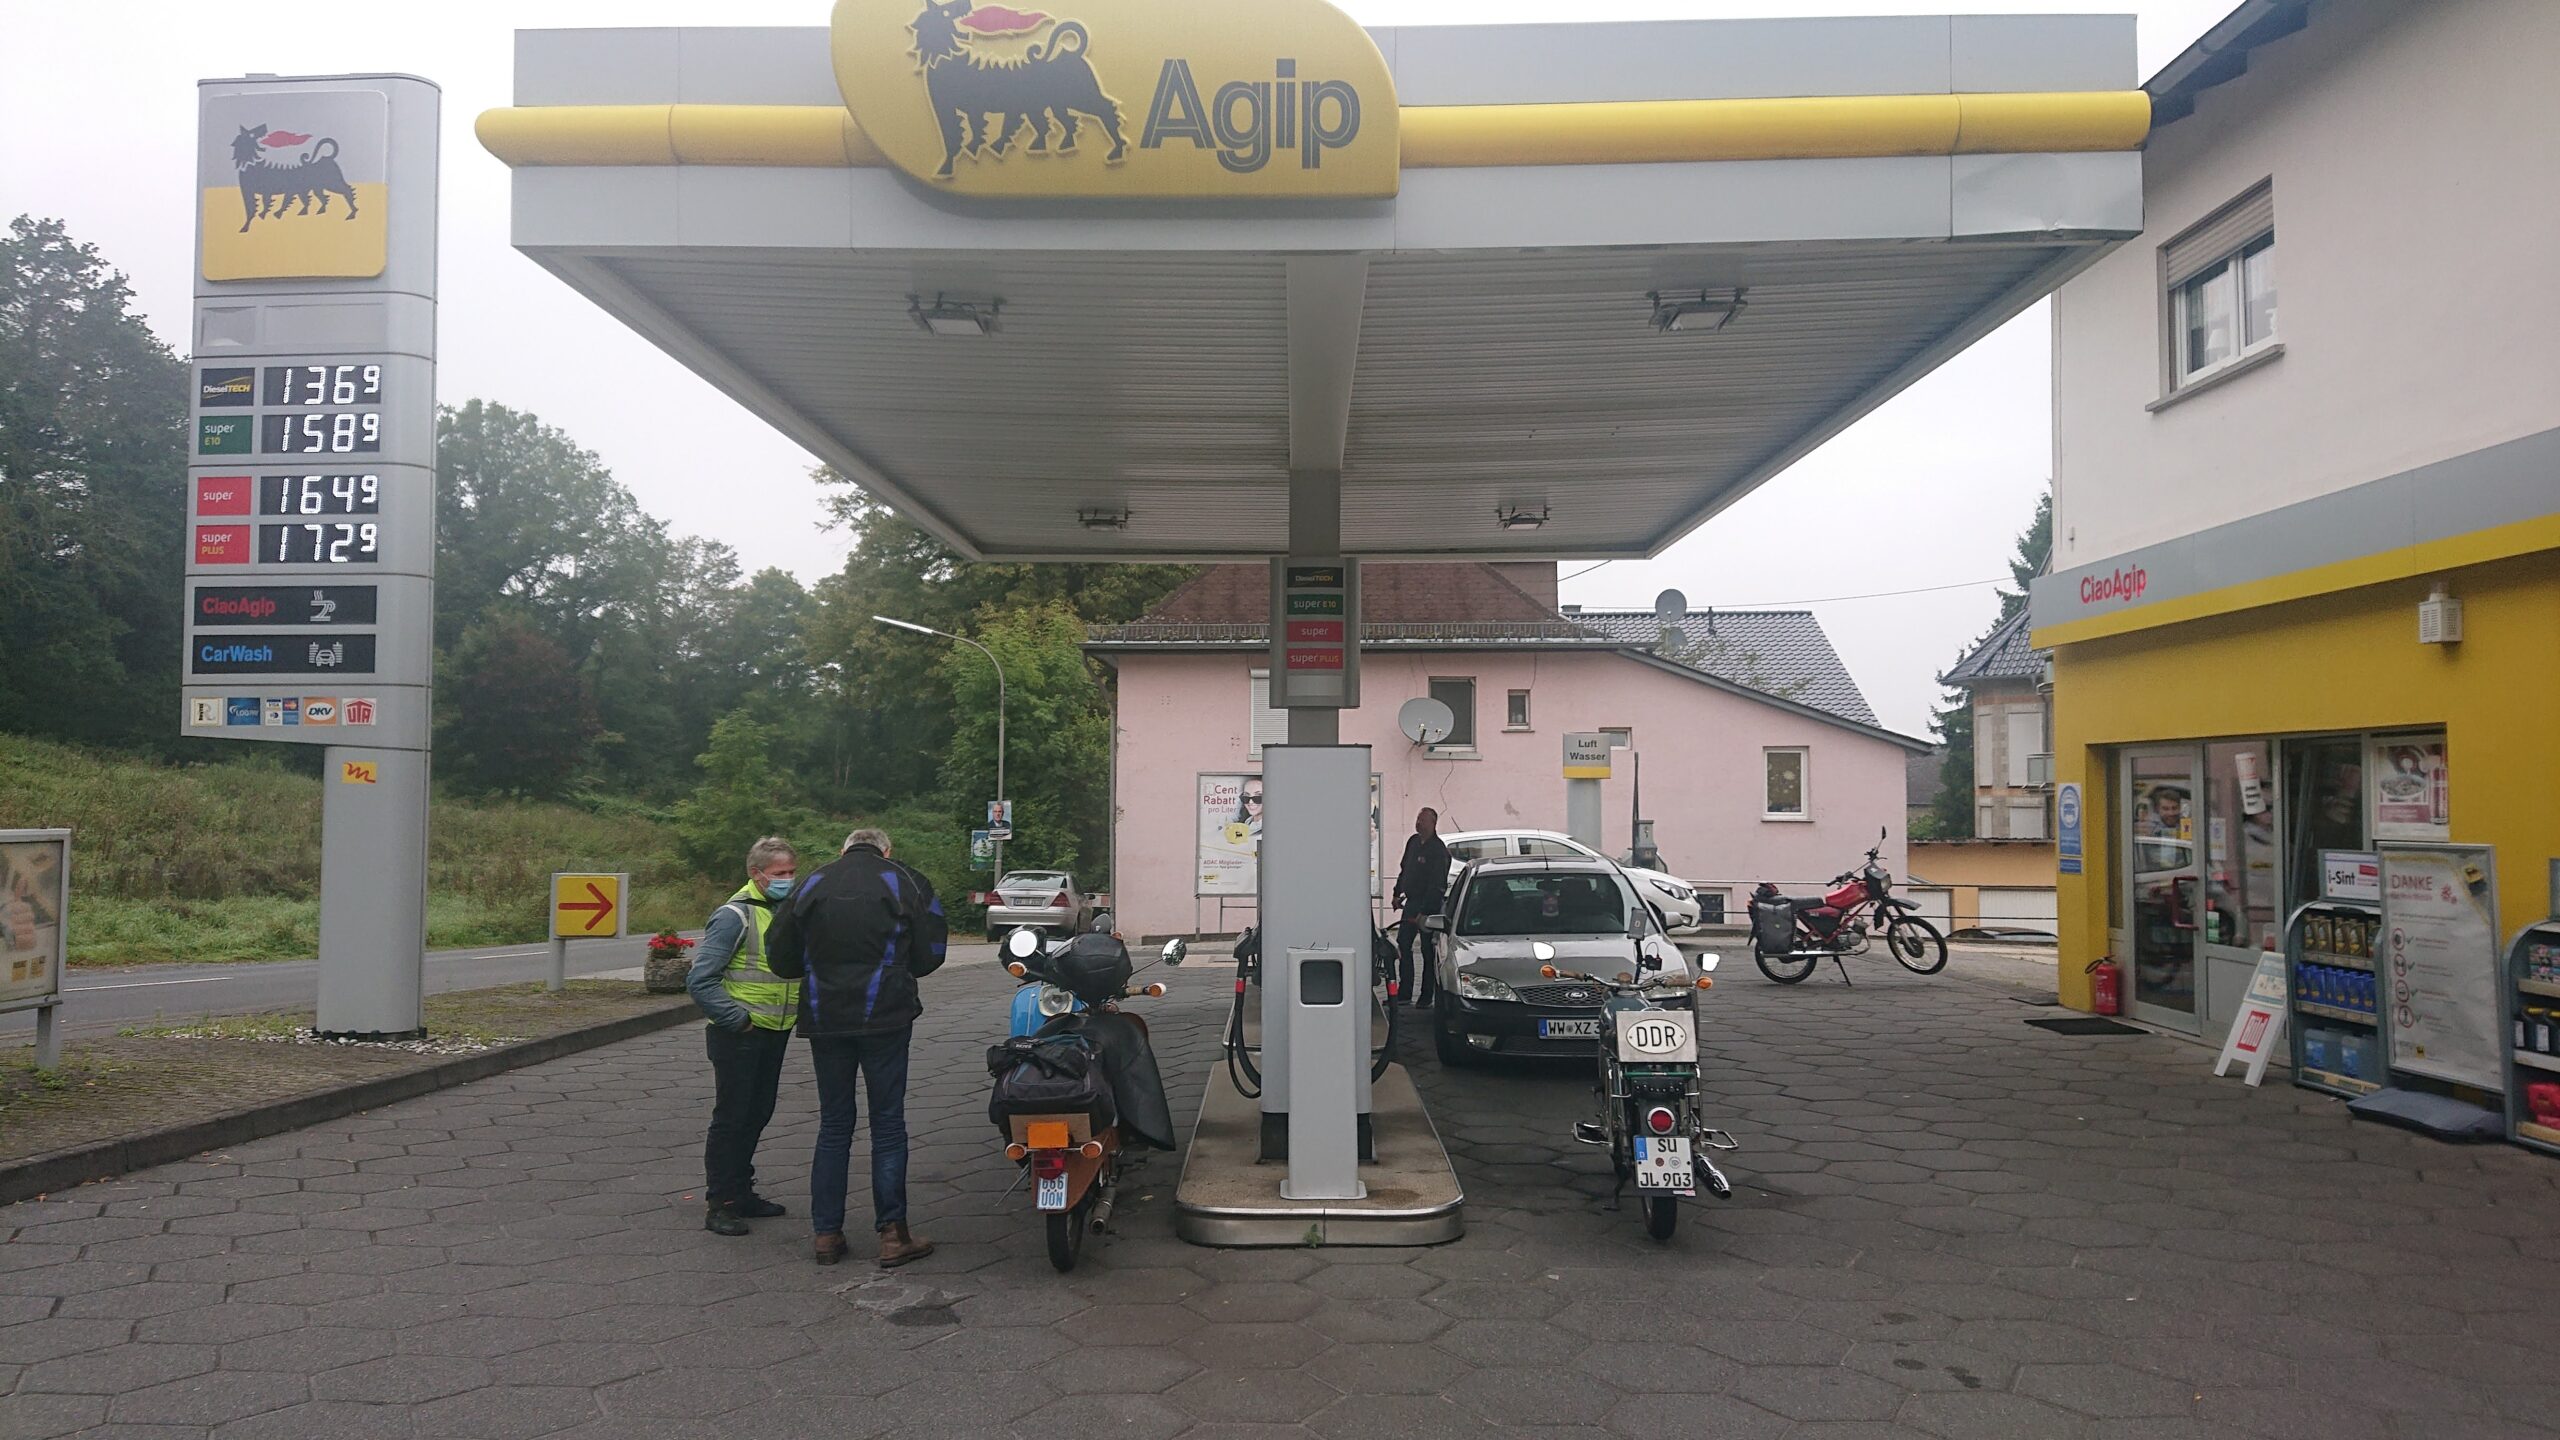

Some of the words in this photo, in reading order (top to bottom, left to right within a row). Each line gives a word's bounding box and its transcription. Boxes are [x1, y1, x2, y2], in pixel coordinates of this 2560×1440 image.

[1139, 58, 1361, 173] Agip
[203, 384, 251, 393] DieselTECH
[204, 424, 236, 435] super
[204, 437, 221, 445] E10
[203, 491, 234, 503] super
[201, 533, 232, 545] super
[201, 546, 224, 555] PLUS
[2080, 564, 2147, 604] CiaoAgip
[202, 596, 277, 618] CiaoAgip
[1293, 600, 1321, 610] super
[1301, 627, 1328, 637] super
[201, 645, 273, 663] CarWash
[1290, 654, 1318, 664] super
[309, 707, 333, 716] DKV
[346, 700, 372, 723] UTA
[1578, 739, 1598, 748] Luft
[1569, 752, 1606, 761] Wasser
[1214, 785, 1238, 794] Cent
[1203, 795, 1236, 805] Rabatt
[1221, 805, 1237, 813] Liter
[2328, 870, 2356, 886] i-Sint
[2391, 875, 2433, 891] DANKE
[1548, 1022, 1565, 1035] WW
[1636, 1026, 1677, 1047] DDR
[1657, 1138, 1678, 1153] SU
[1640, 1172, 1660, 1187] JL
[1663, 1172, 1691, 1187] 903
